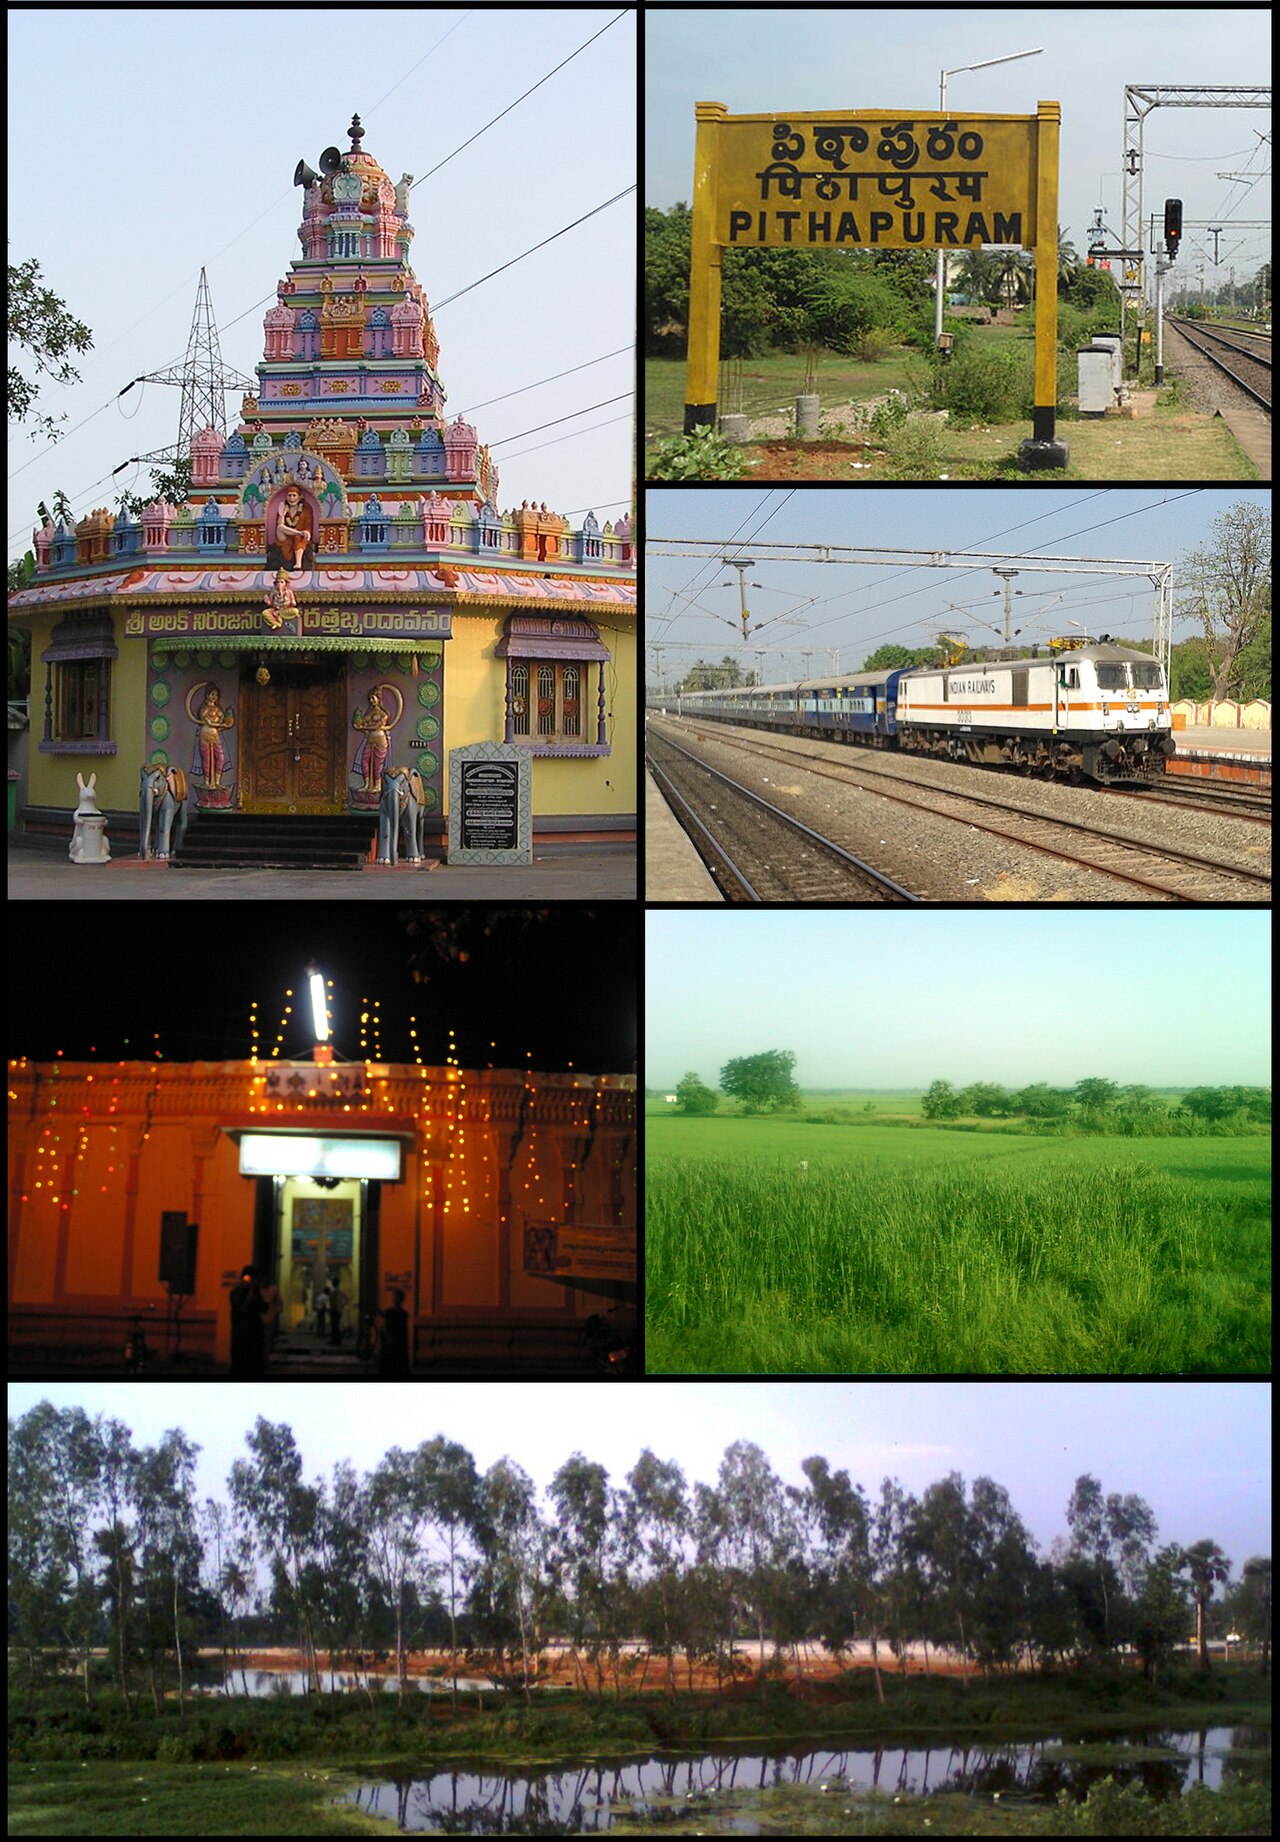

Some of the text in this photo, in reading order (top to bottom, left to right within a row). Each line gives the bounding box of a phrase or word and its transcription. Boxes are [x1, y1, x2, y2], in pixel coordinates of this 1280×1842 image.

[755, 162, 988, 209] पिठापुरम
[730, 211, 1022, 243] PITHAPURAM
[126, 610, 145, 634] శ్రీ
[949, 680, 996, 695] INDIAN RAILWAYS
